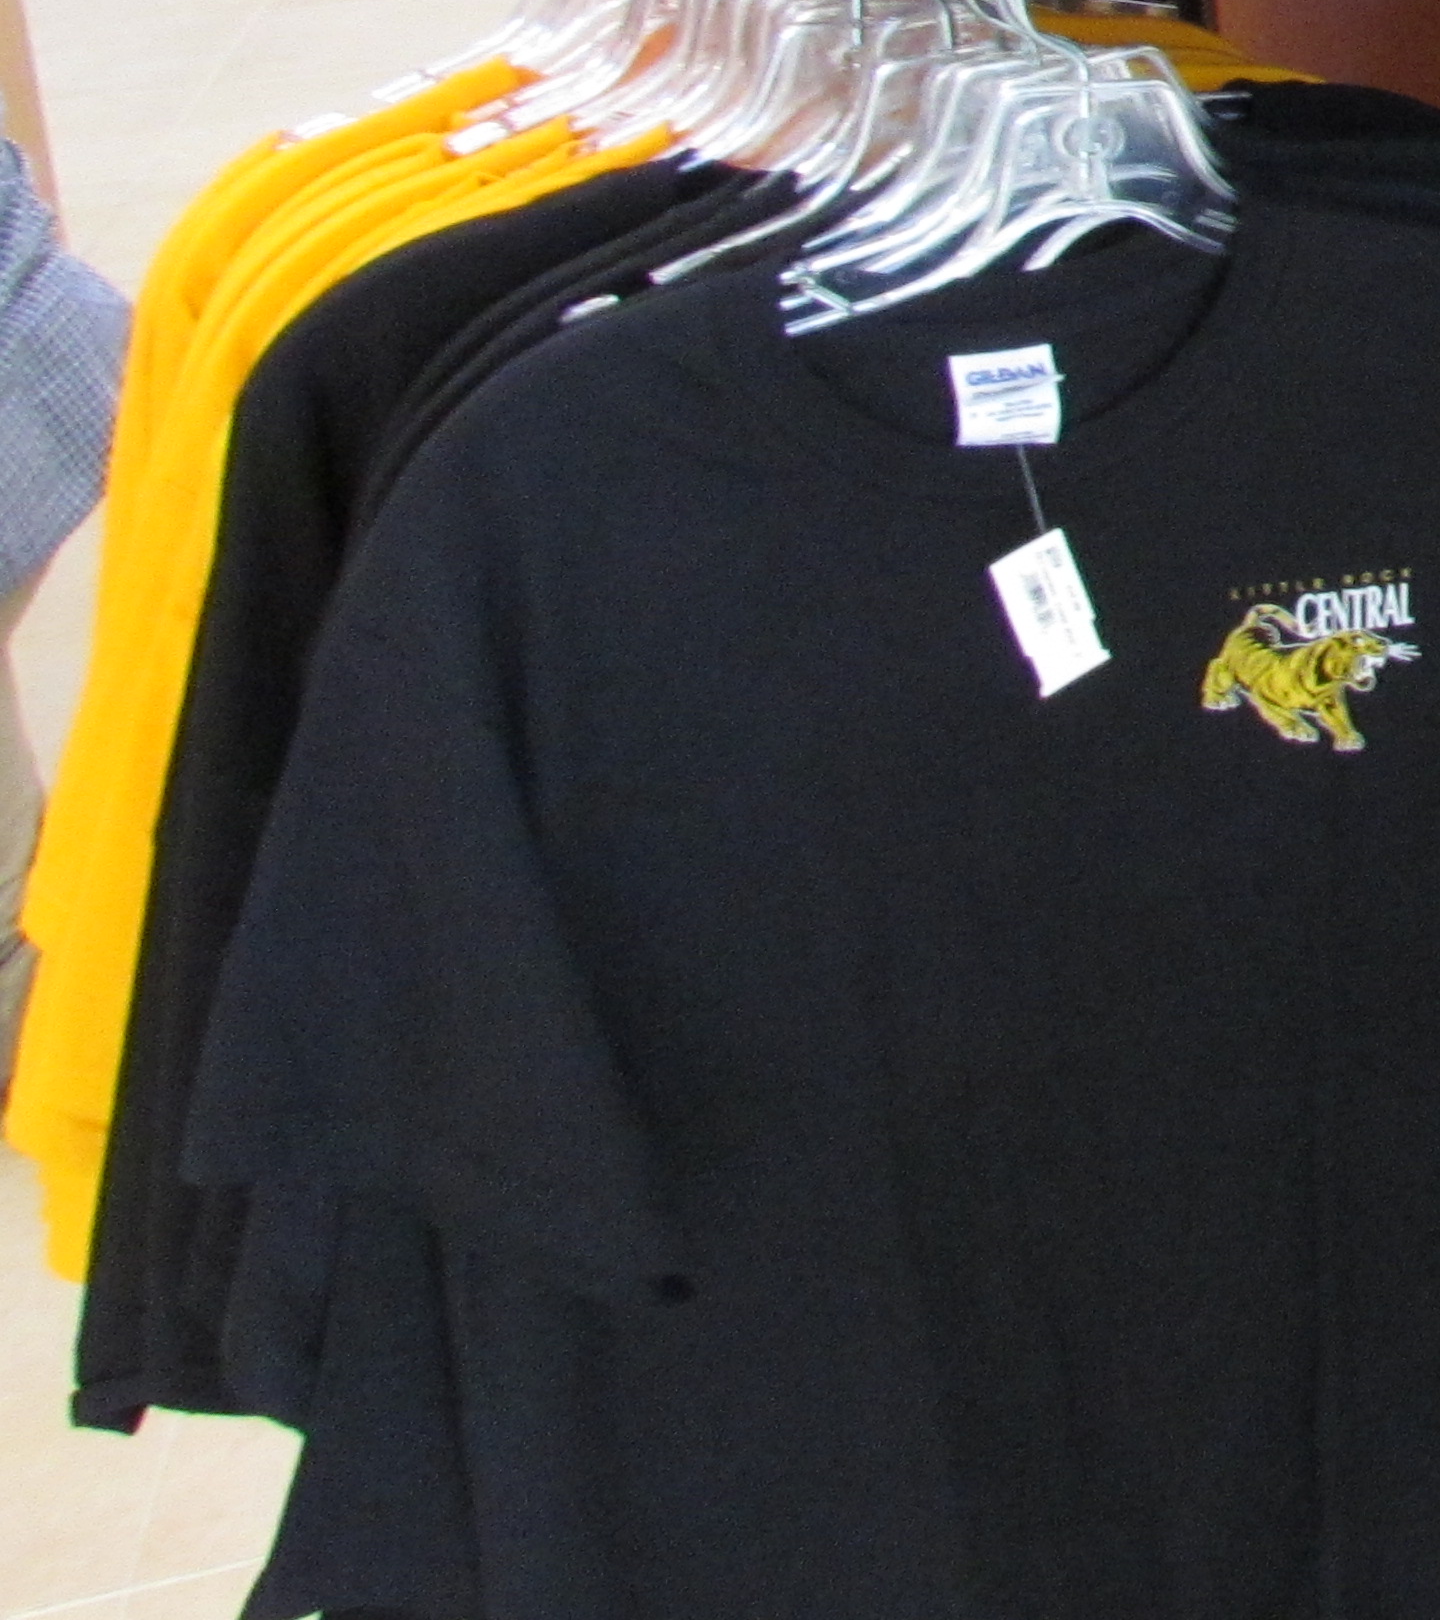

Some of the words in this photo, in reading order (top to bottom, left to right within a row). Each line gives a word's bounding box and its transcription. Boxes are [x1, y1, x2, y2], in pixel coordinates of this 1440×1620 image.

[1229, 578, 1325, 602] LITTLE
[1341, 566, 1413, 586] ROCK
[1295, 581, 1416, 639] CENTRAL
